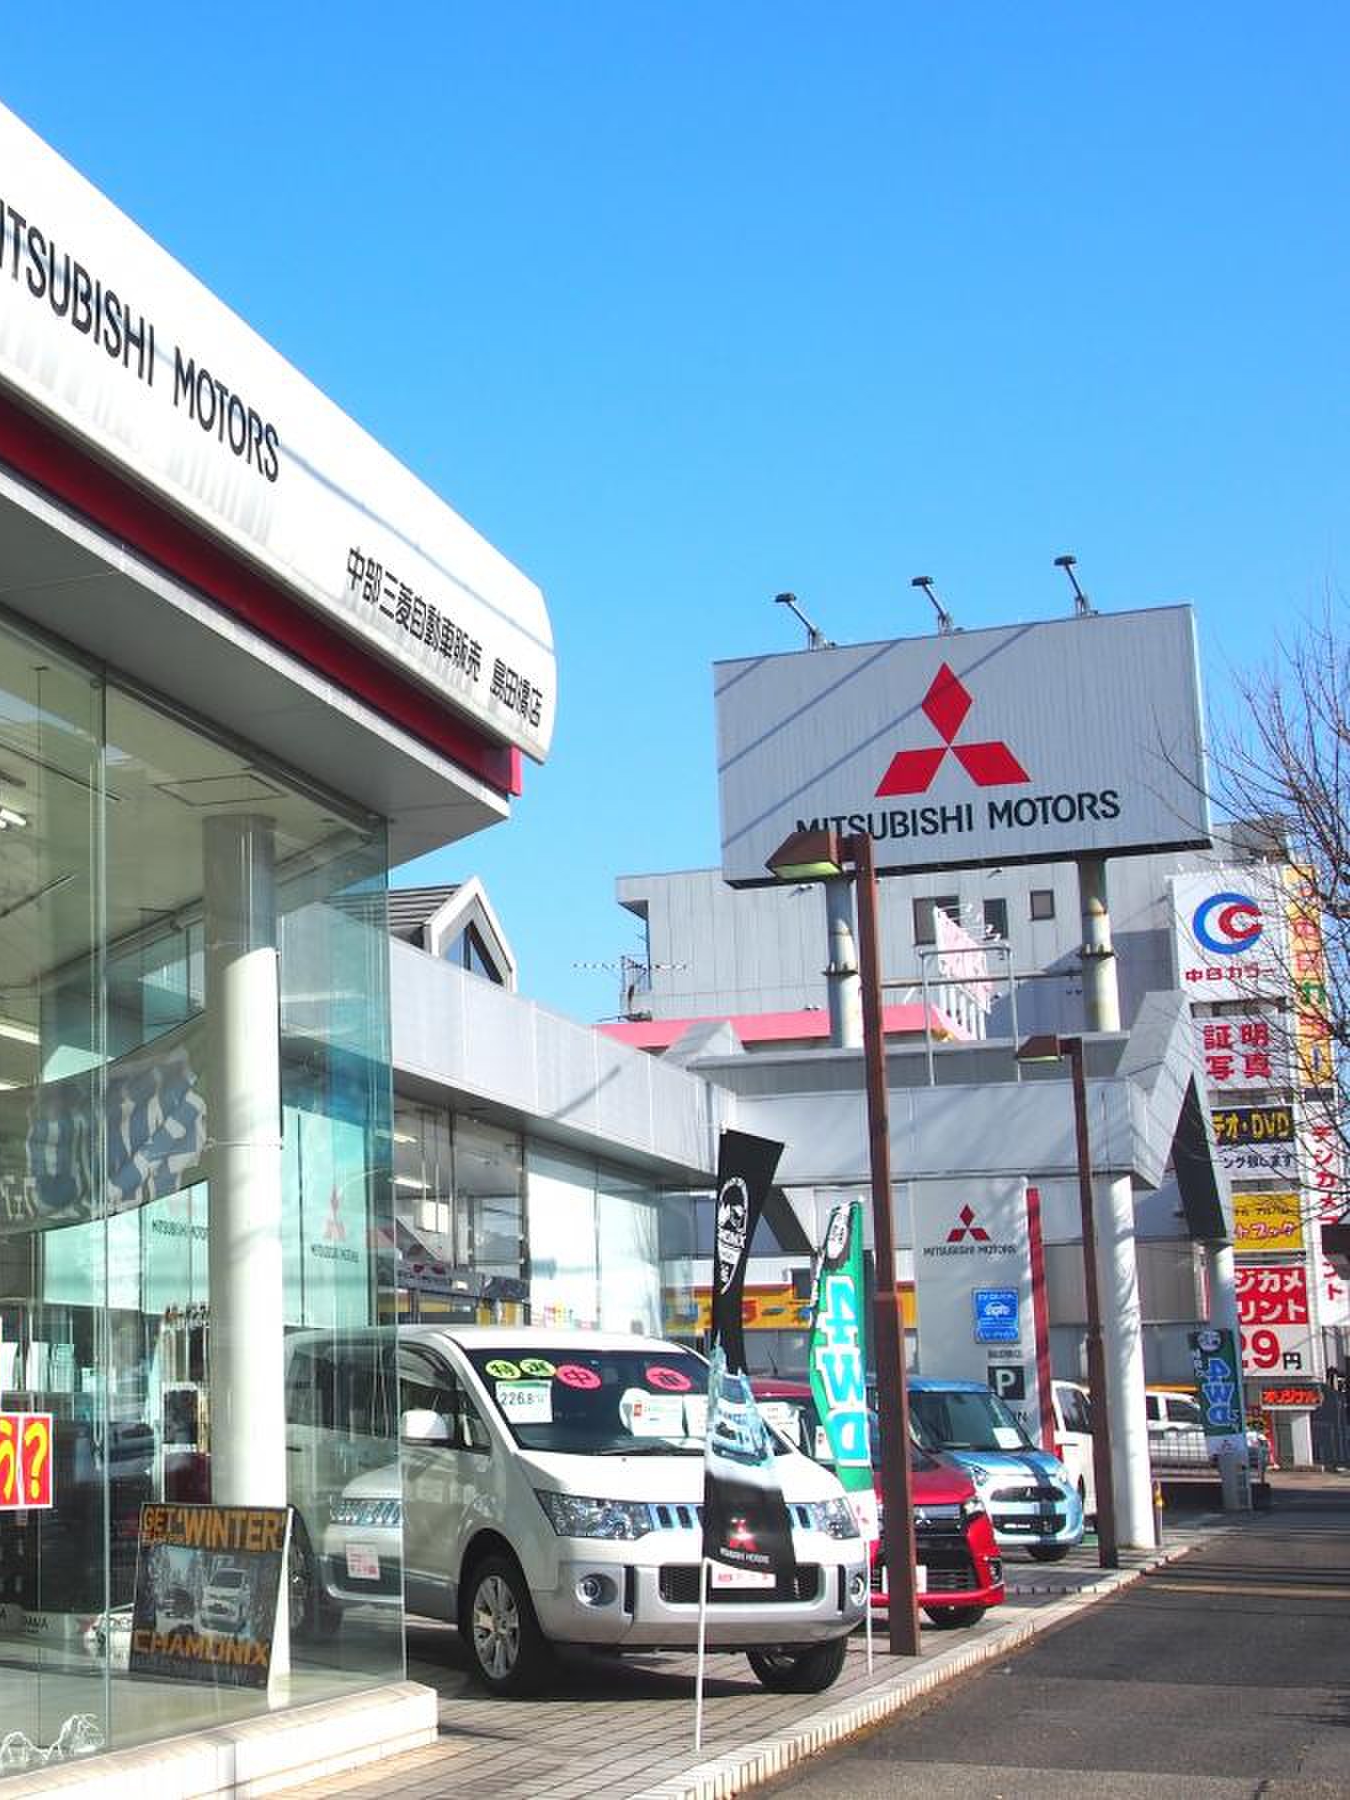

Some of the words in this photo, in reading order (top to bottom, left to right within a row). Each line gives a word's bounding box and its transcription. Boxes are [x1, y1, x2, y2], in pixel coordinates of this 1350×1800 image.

[173, 345, 280, 483] MOTORS
[989, 789, 1121, 829] MOTORS
[1203, 1023, 1270, 1050] 証明
[1206, 1053, 1272, 1080] 写真
[995, 1369, 1016, 1396] P
